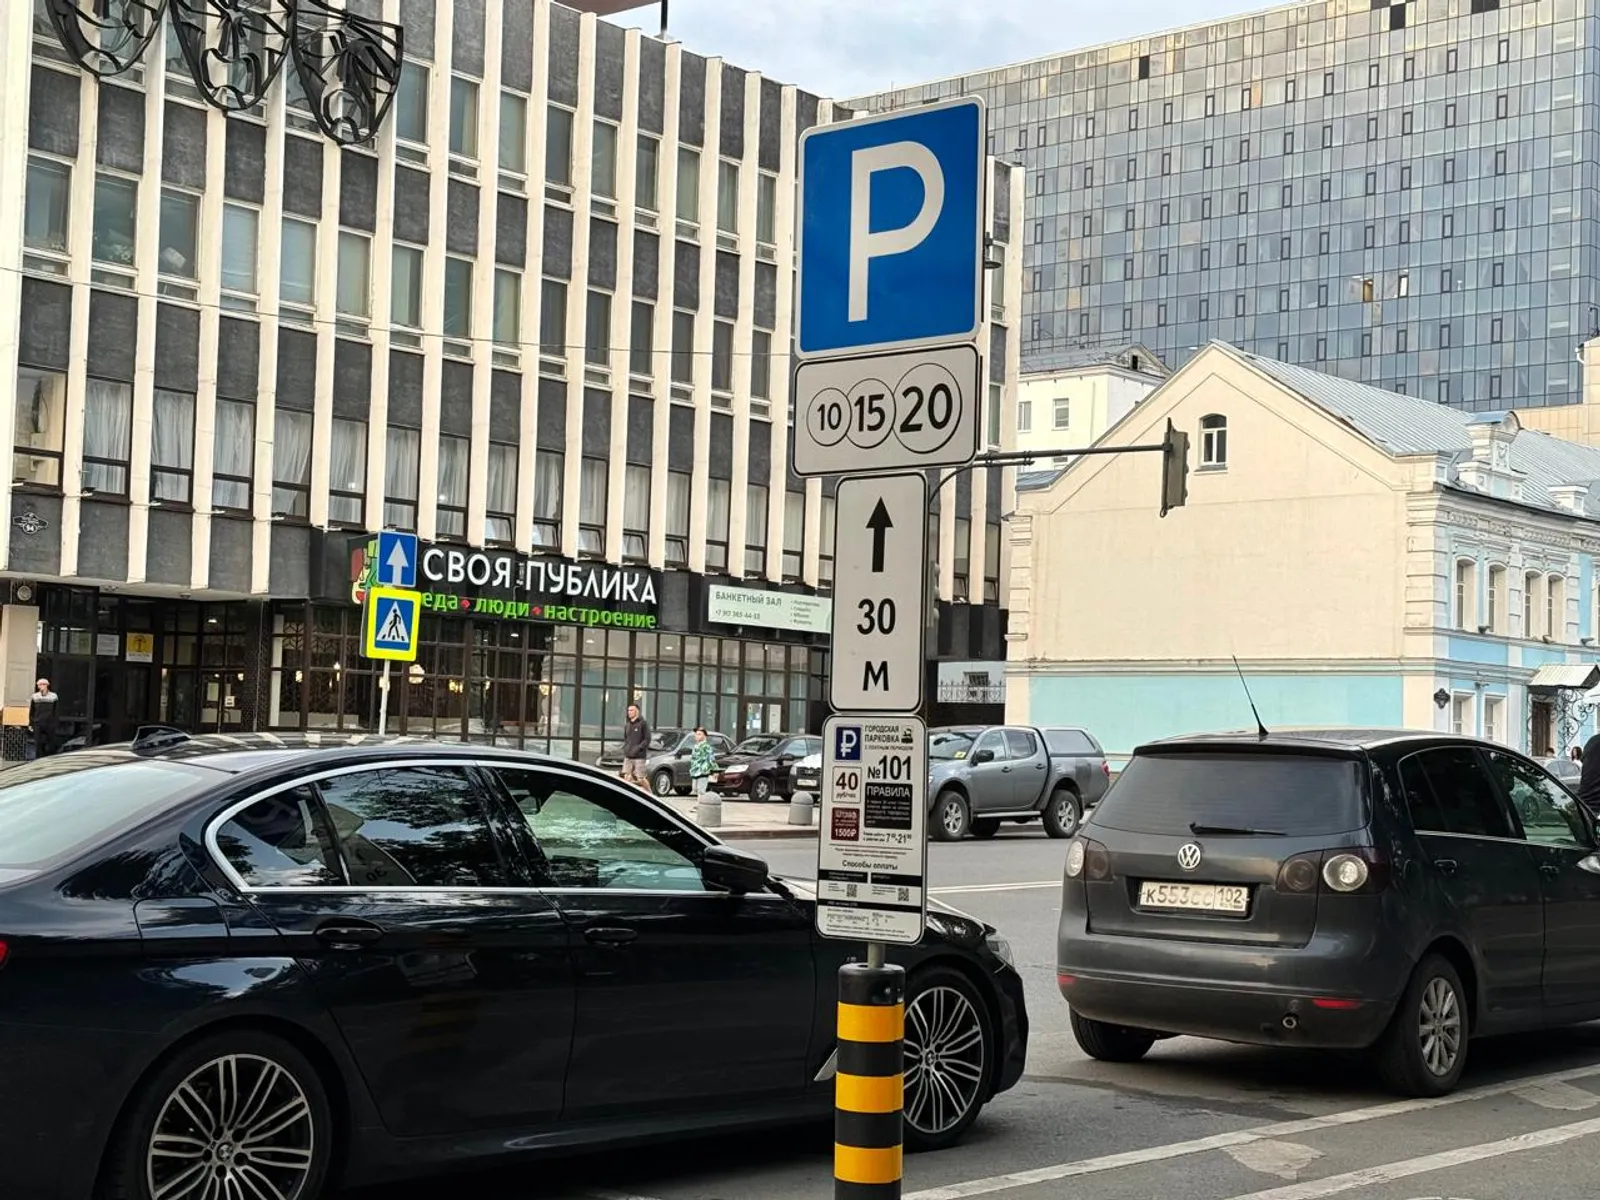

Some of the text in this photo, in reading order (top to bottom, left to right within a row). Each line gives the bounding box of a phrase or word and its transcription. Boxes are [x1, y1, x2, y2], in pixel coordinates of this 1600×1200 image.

[848, 141, 945, 322] P
[816, 382, 953, 433] 10 15 20
[423, 549, 658, 605] СВОЯ ПУБЛИКА
[421, 591, 458, 611] еда
[473, 597, 530, 618] люди
[715, 591, 764, 604] БАНКЕТНЫЙ
[766, 596, 782, 607] ЗАЛ
[857, 598, 896, 635] 30
[865, 725, 899, 733] ГОРОДСКАЯ
[865, 735, 900, 743] ПАРКОВКА
[836, 772, 858, 790] 40
[866, 785, 911, 798] ПРАВИЛА
[841, 860, 898, 870] Способы оплаты
[1218, 888, 1243, 903] 102
